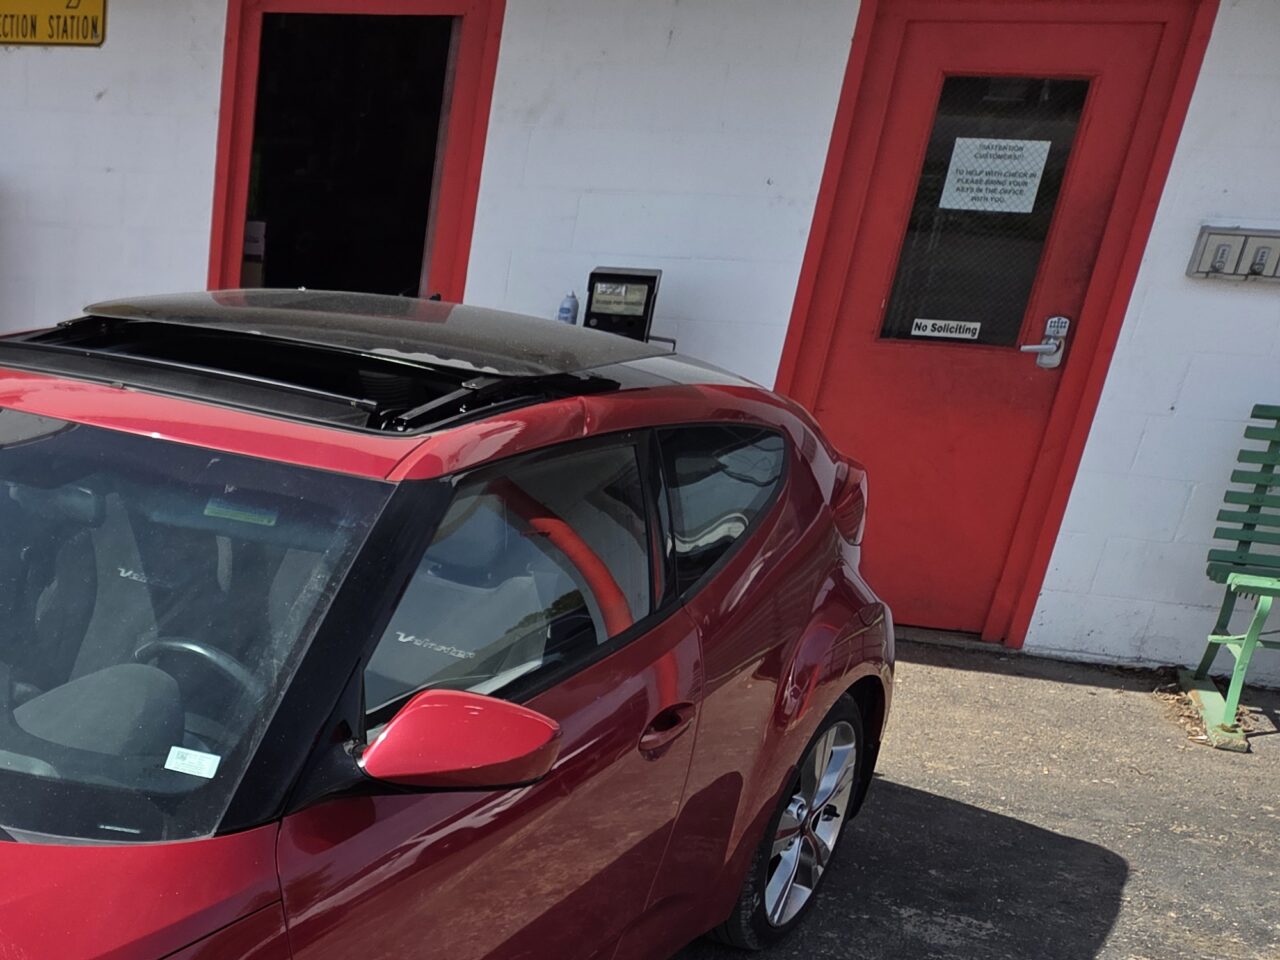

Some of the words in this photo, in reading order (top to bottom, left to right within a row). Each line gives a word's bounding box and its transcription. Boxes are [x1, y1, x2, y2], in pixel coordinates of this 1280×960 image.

[48, 15, 99, 40] STATION
[985, 169, 1003, 177] WITH
[914, 321, 928, 332] No
[930, 322, 978, 338] Soliciting
